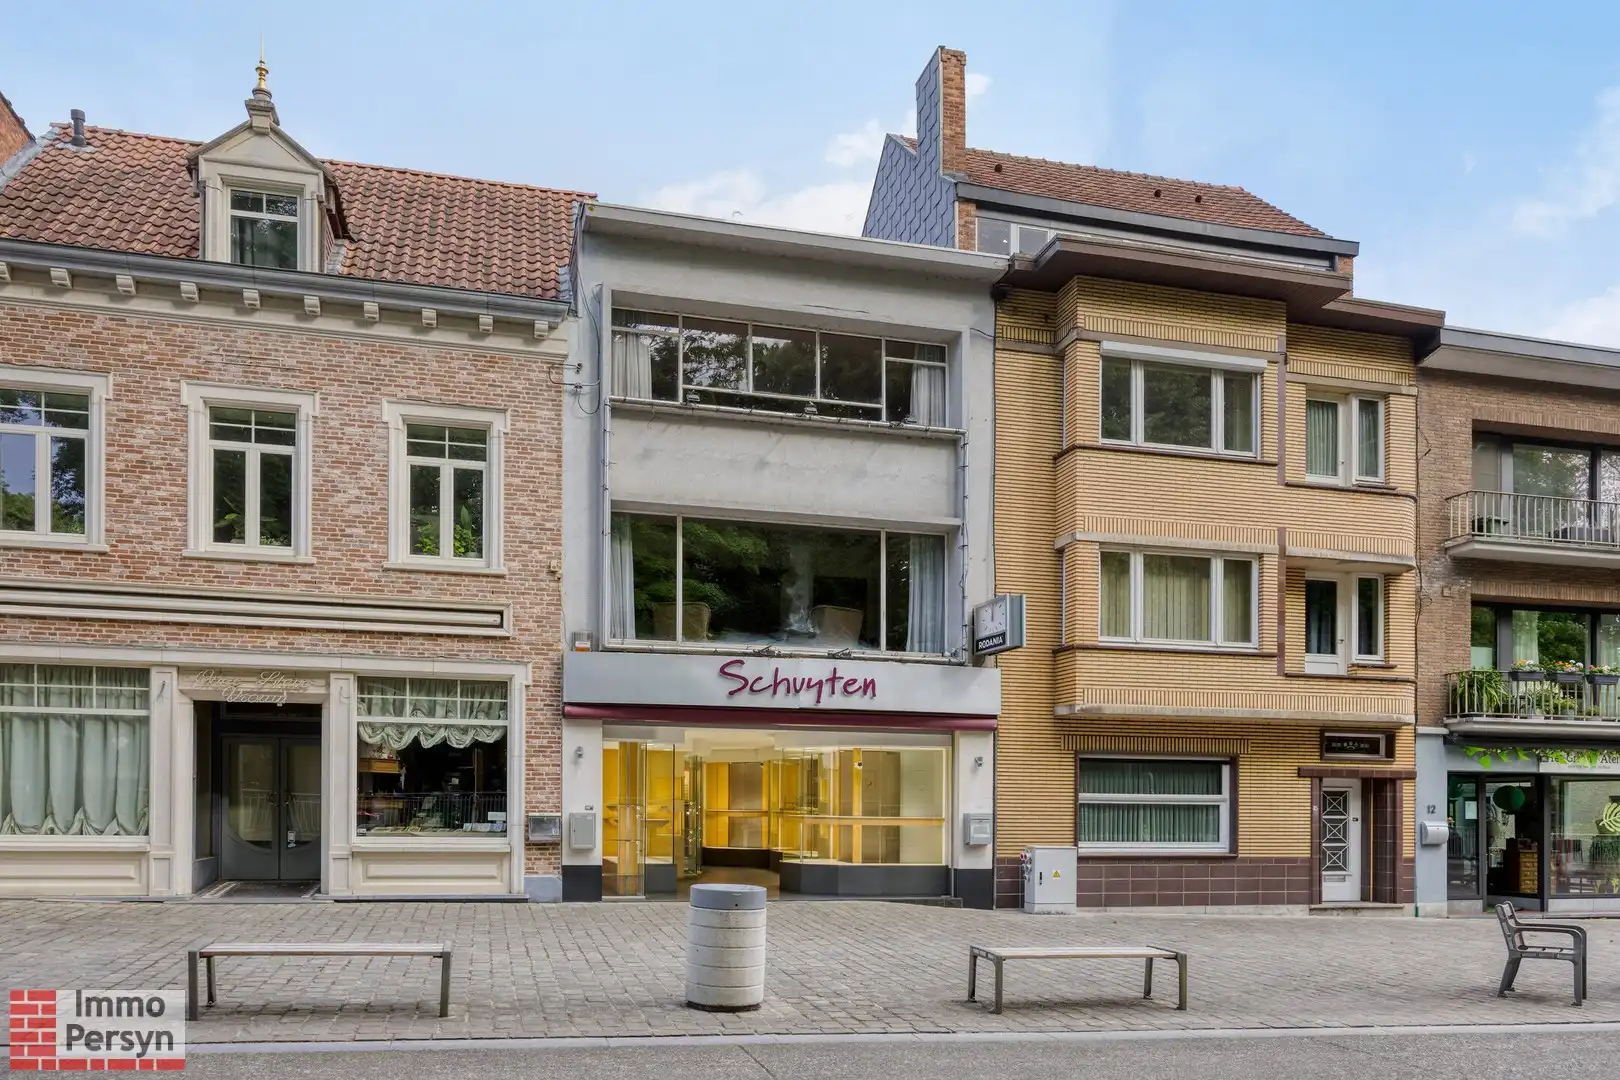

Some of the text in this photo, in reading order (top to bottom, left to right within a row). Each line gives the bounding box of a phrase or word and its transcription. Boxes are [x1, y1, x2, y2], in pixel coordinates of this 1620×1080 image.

[978, 636, 1004, 650] RODANIA
[719, 659, 877, 704] Schuyten
[1427, 804, 1436, 815] 12
